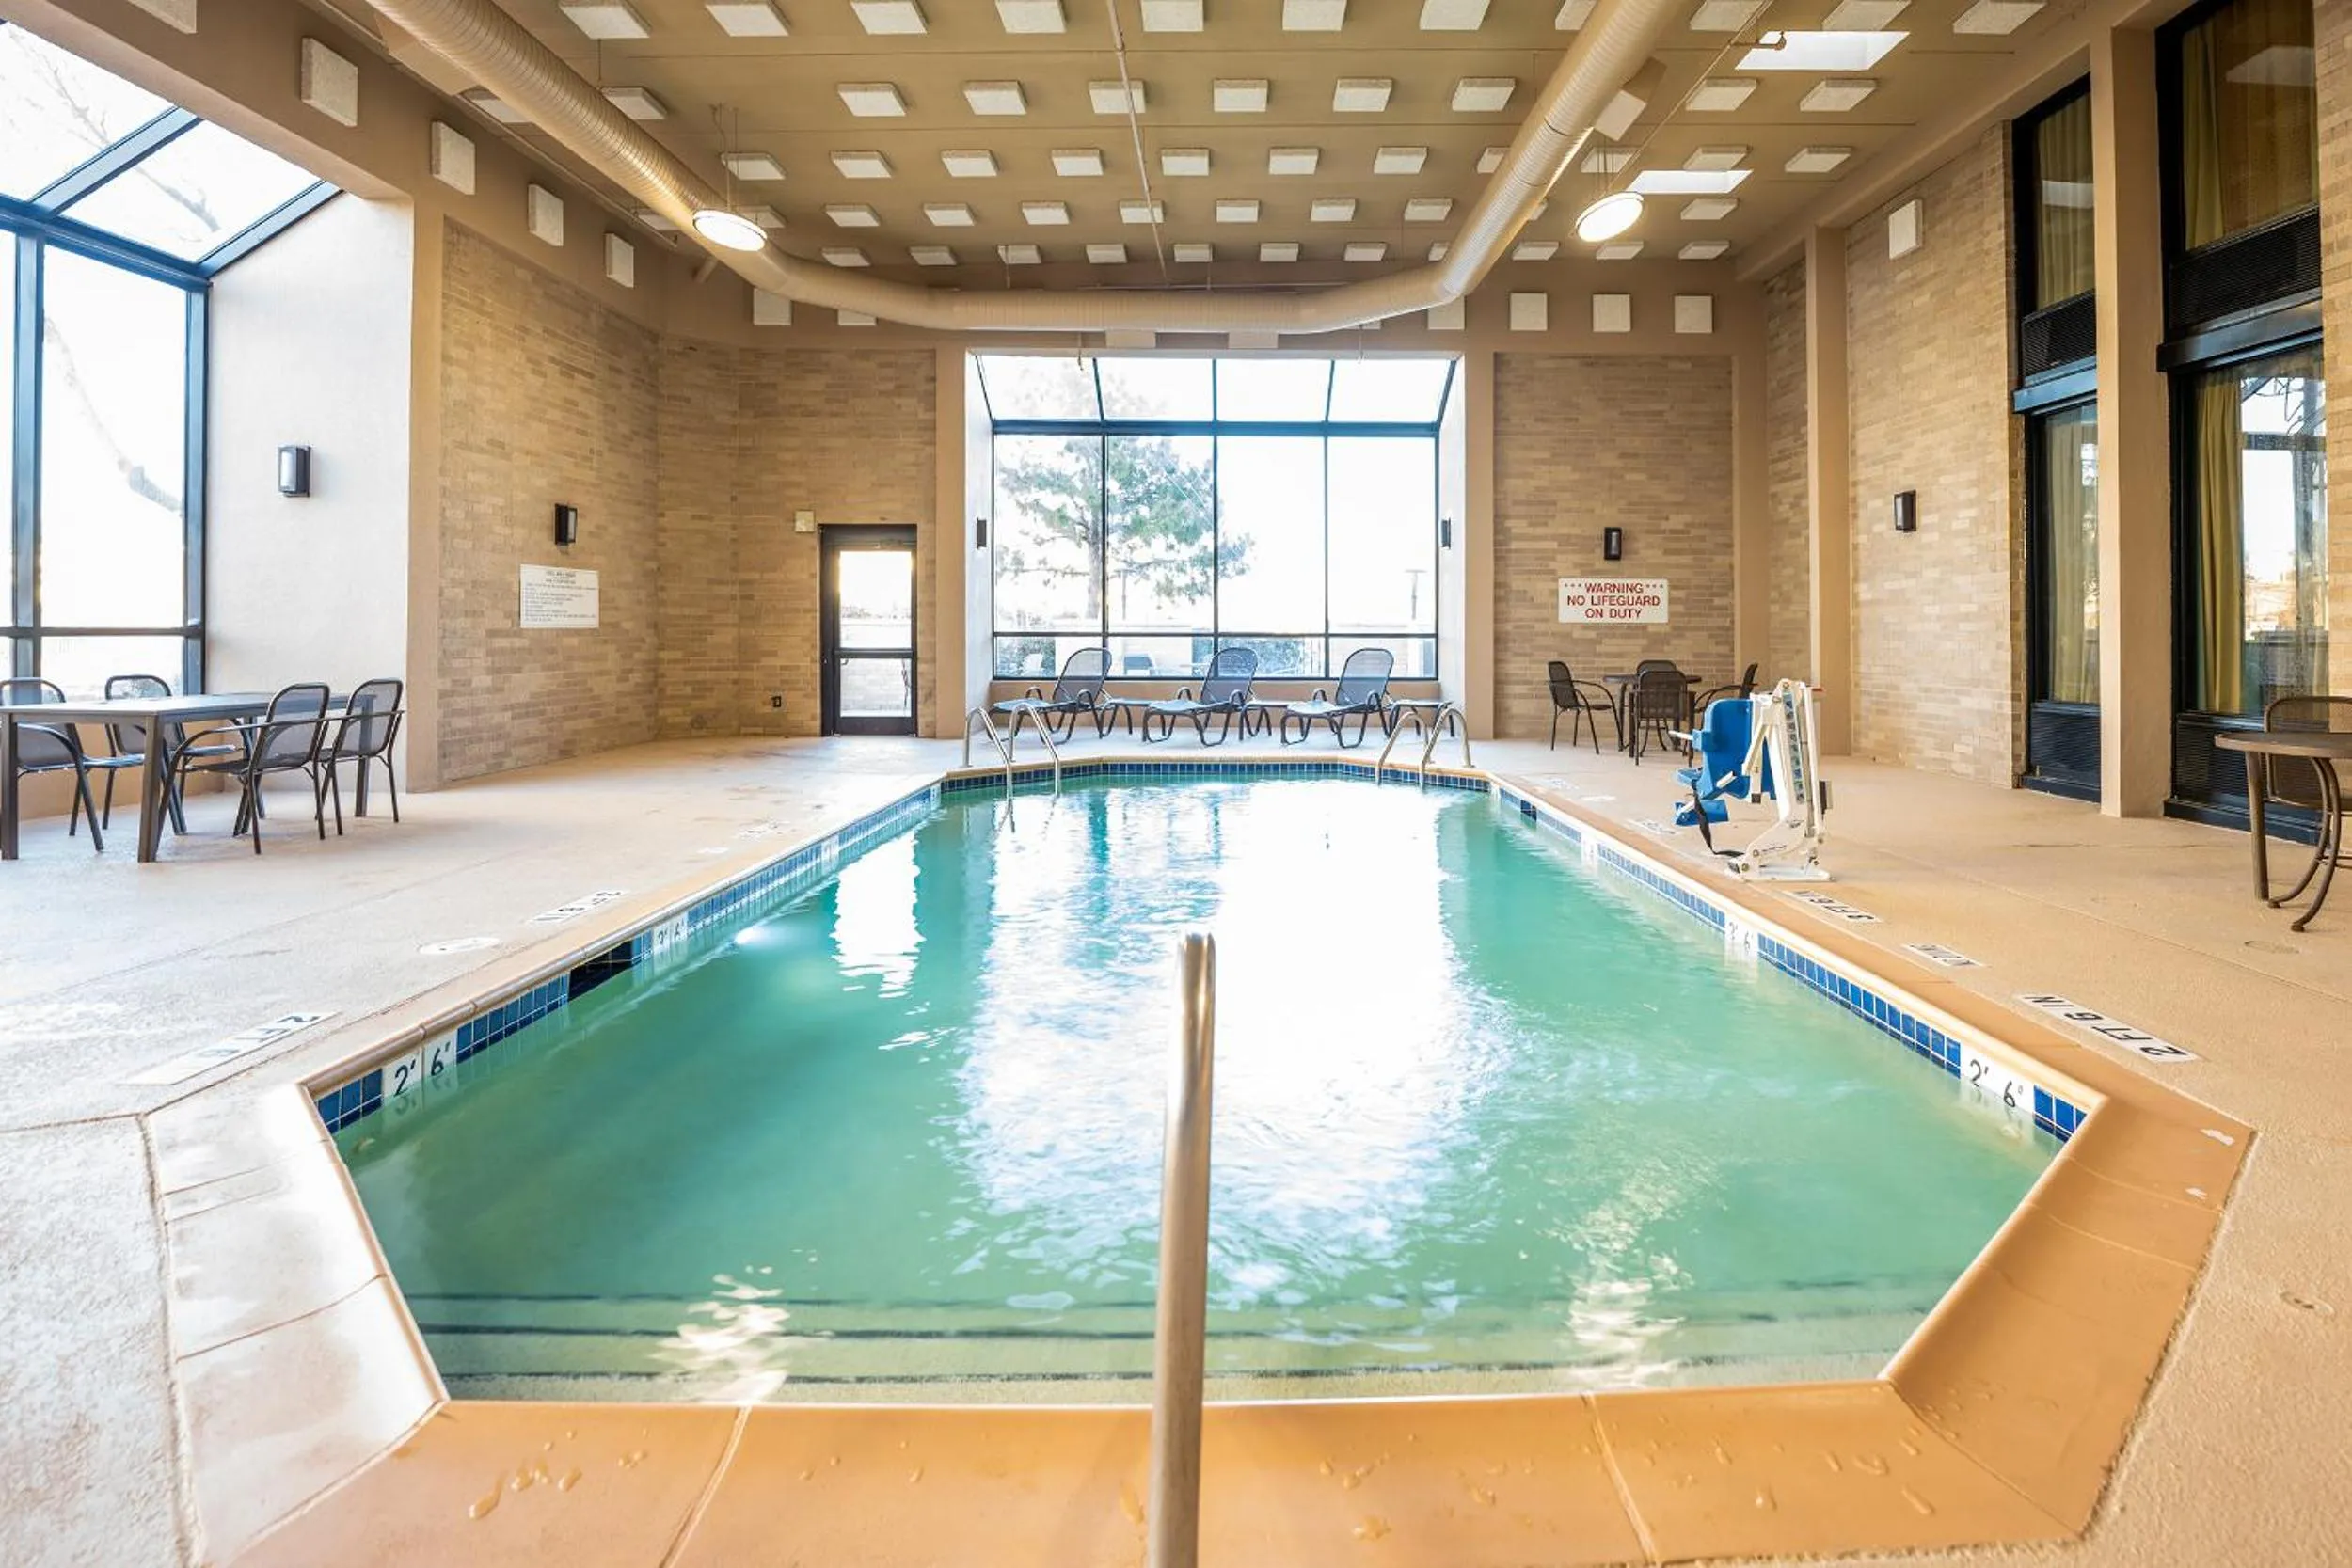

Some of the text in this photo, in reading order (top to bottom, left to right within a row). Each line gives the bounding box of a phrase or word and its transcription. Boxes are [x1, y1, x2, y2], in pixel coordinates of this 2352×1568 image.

[1584, 582, 1644, 593] WARNING
[1567, 595, 1661, 606] NO LIFEGUARD
[1585, 608, 1642, 618] ON DUTY
[2024, 995, 2188, 1056] 2 FT 6 IN
